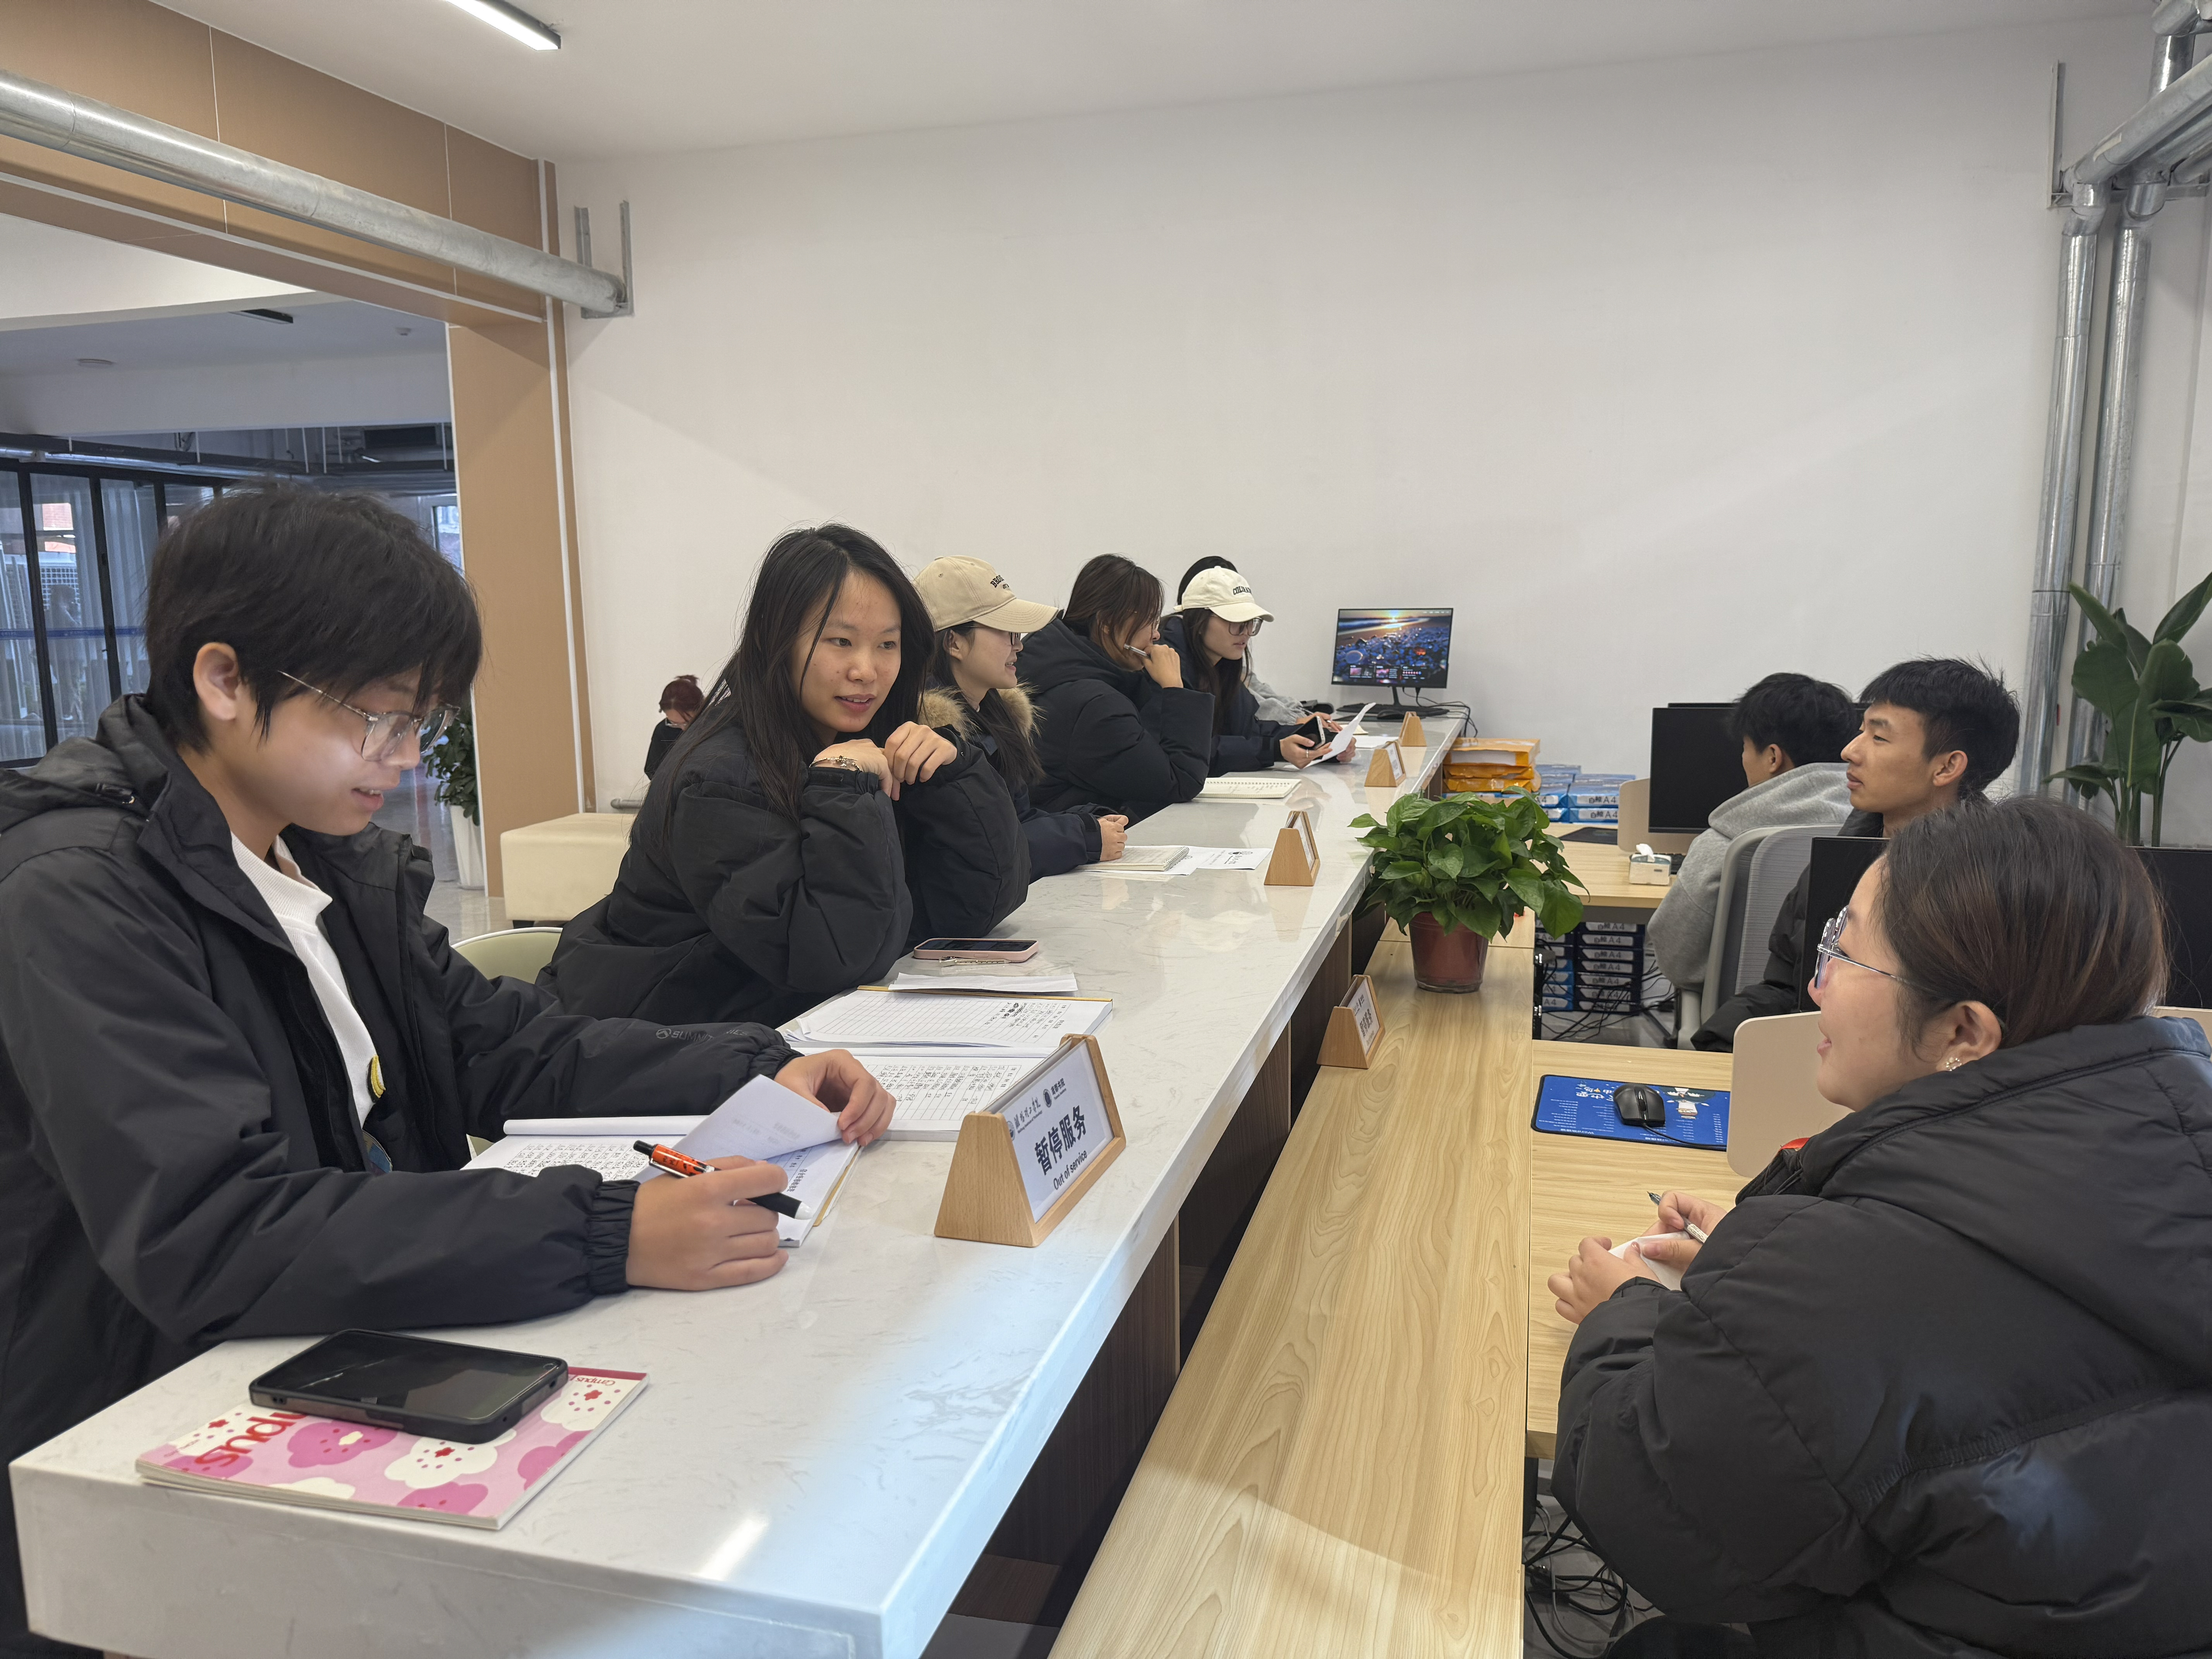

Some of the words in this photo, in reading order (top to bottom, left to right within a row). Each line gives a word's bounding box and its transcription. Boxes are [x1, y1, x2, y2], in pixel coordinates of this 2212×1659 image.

[1034, 1105, 1086, 1176] 暂停服务
[1053, 1173, 1065, 1190] Out
[1064, 1164, 1070, 1179] of
[1070, 1150, 1087, 1173] service
[575, 1377, 616, 1386] Campus
[195, 1412, 308, 1467] pus
